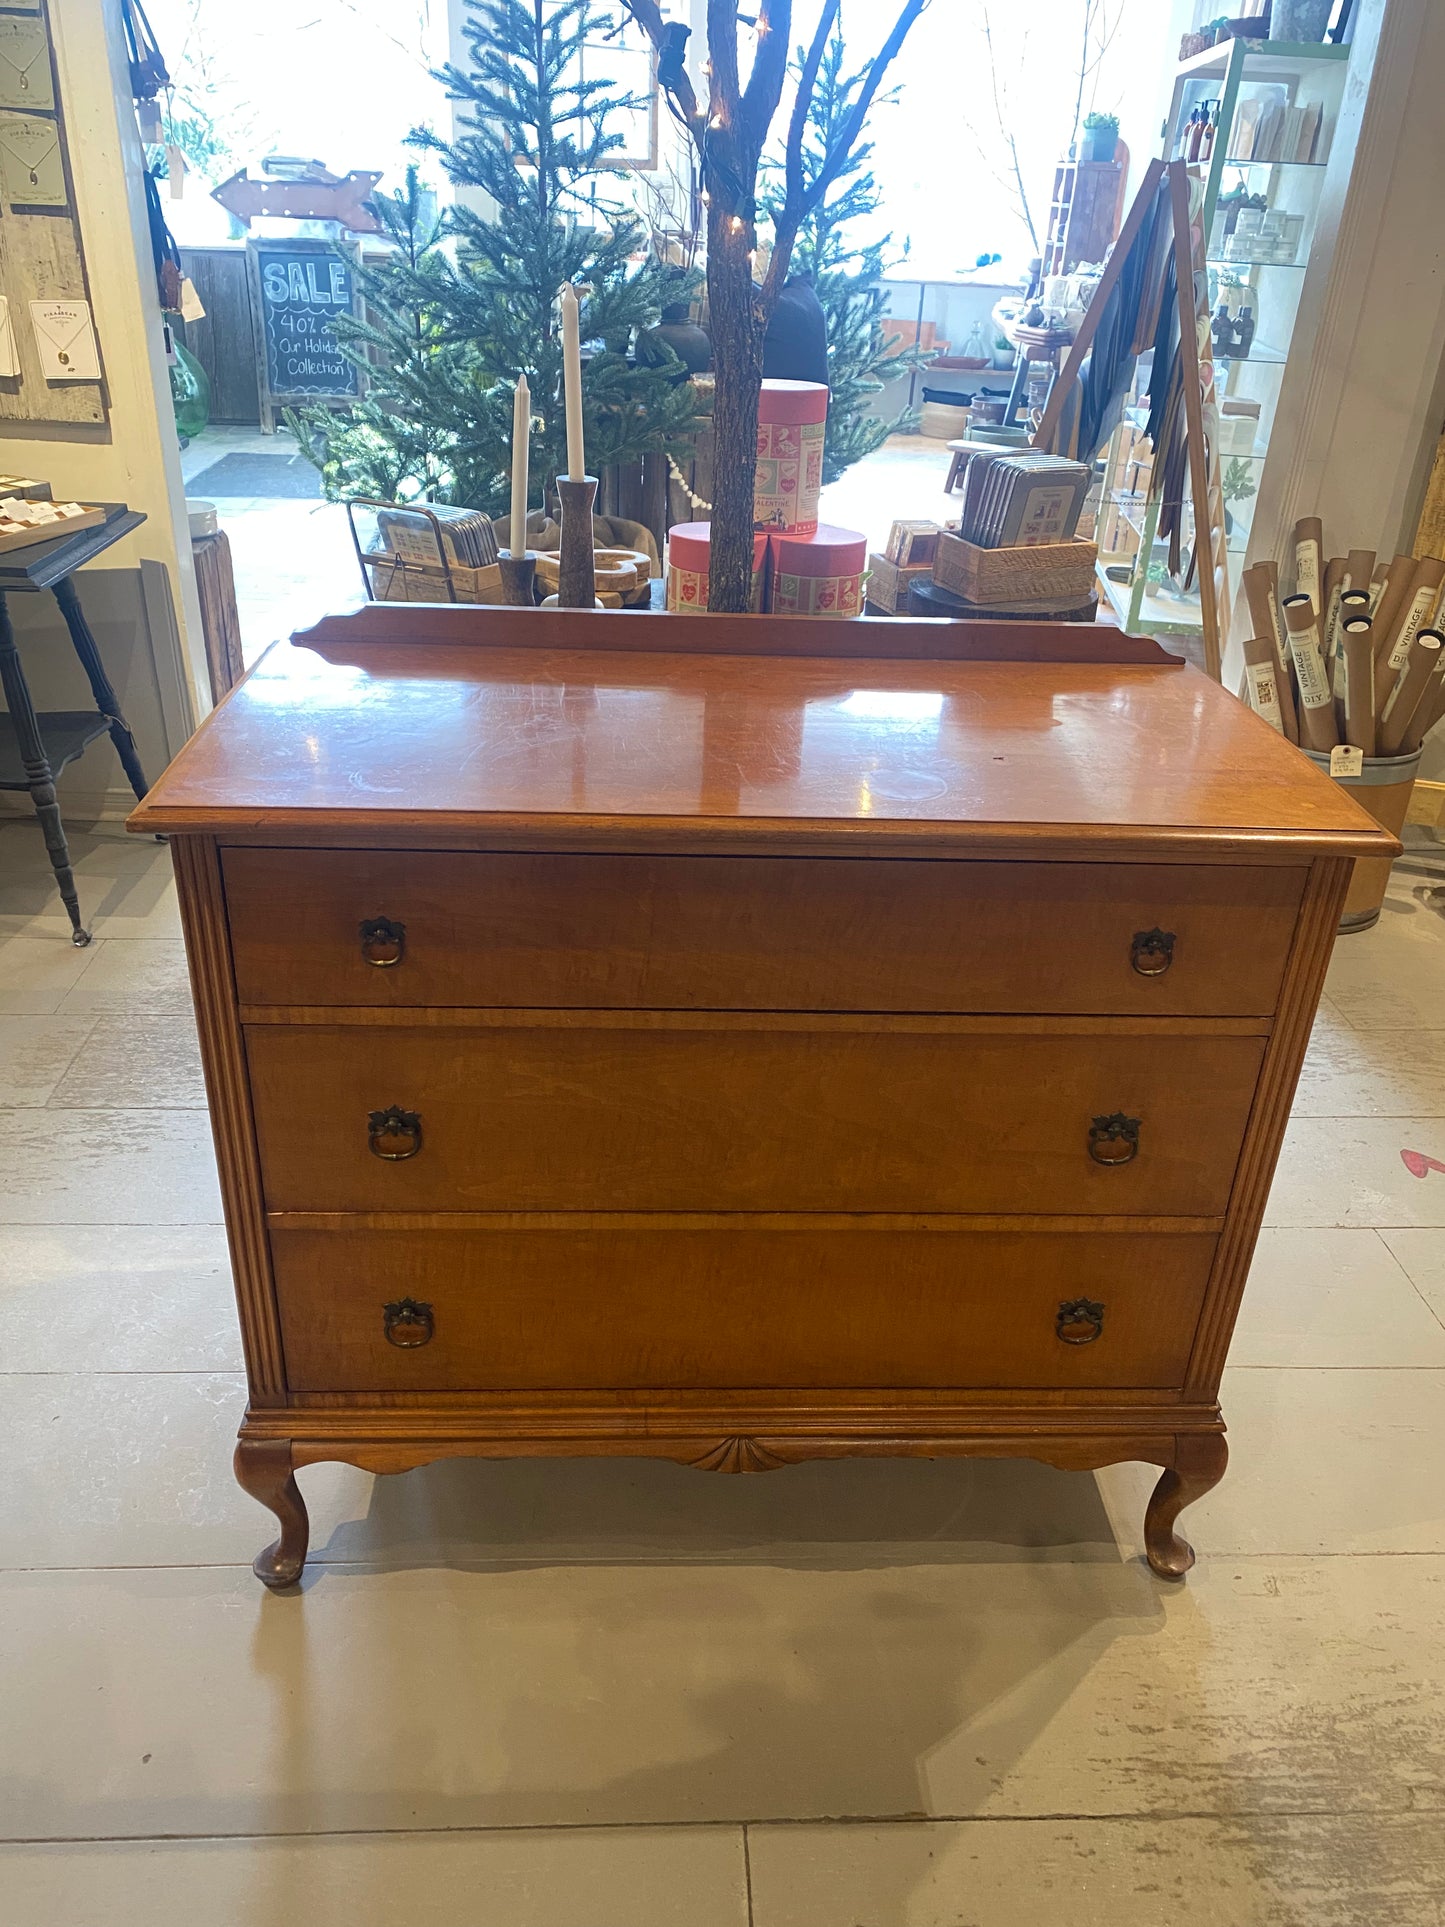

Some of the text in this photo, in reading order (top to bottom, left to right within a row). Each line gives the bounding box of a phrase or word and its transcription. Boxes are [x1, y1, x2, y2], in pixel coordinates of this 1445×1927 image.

[263, 262, 350, 304] SALE
[280, 315, 316, 333] 40%
[280, 338, 301, 353] Our
[287, 358, 344, 375] Collection
[1400, 608, 1423, 647] VINTAGE
[1295, 651, 1309, 688] VINTAGE
[1304, 694, 1322, 703] DIY
